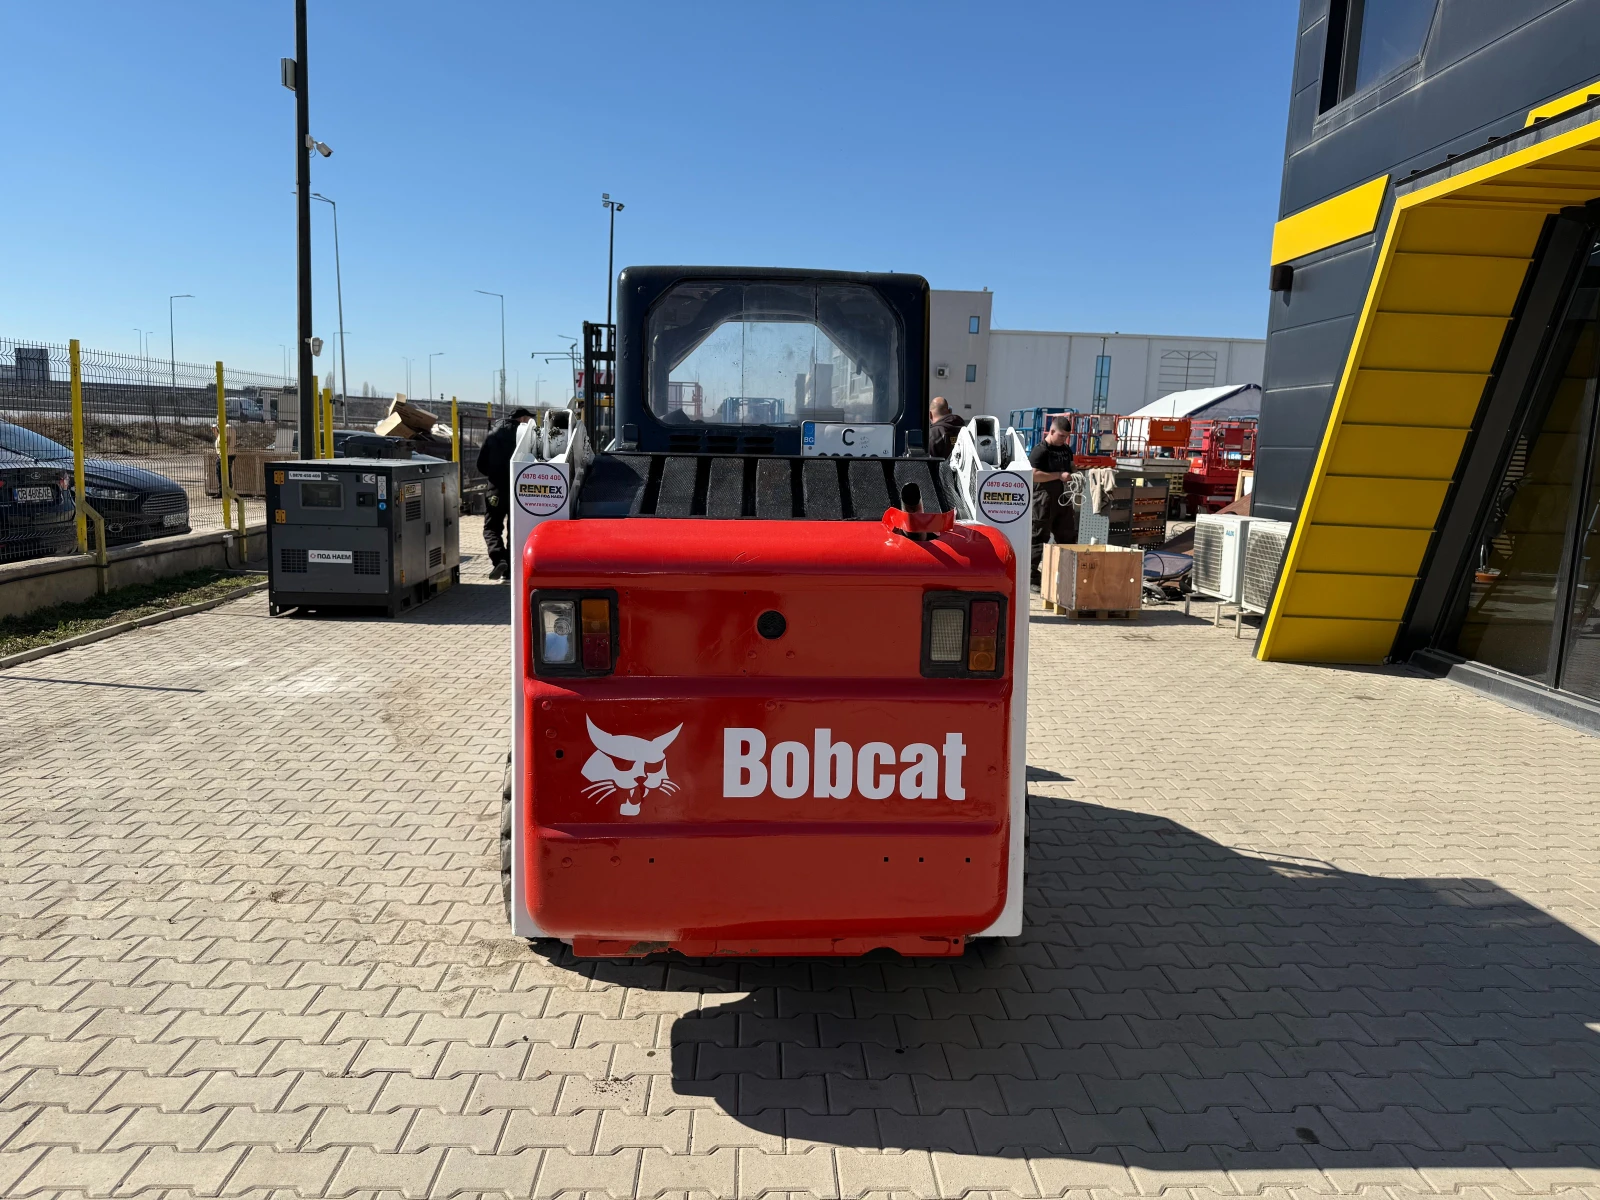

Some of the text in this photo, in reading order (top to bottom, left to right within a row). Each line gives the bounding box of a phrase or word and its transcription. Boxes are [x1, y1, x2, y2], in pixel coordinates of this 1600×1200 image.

[842, 428, 855, 446] C
[519, 484, 563, 494] RENTEX
[983, 492, 1025, 501] RENTEX
[723, 727, 967, 801] Bobcat
